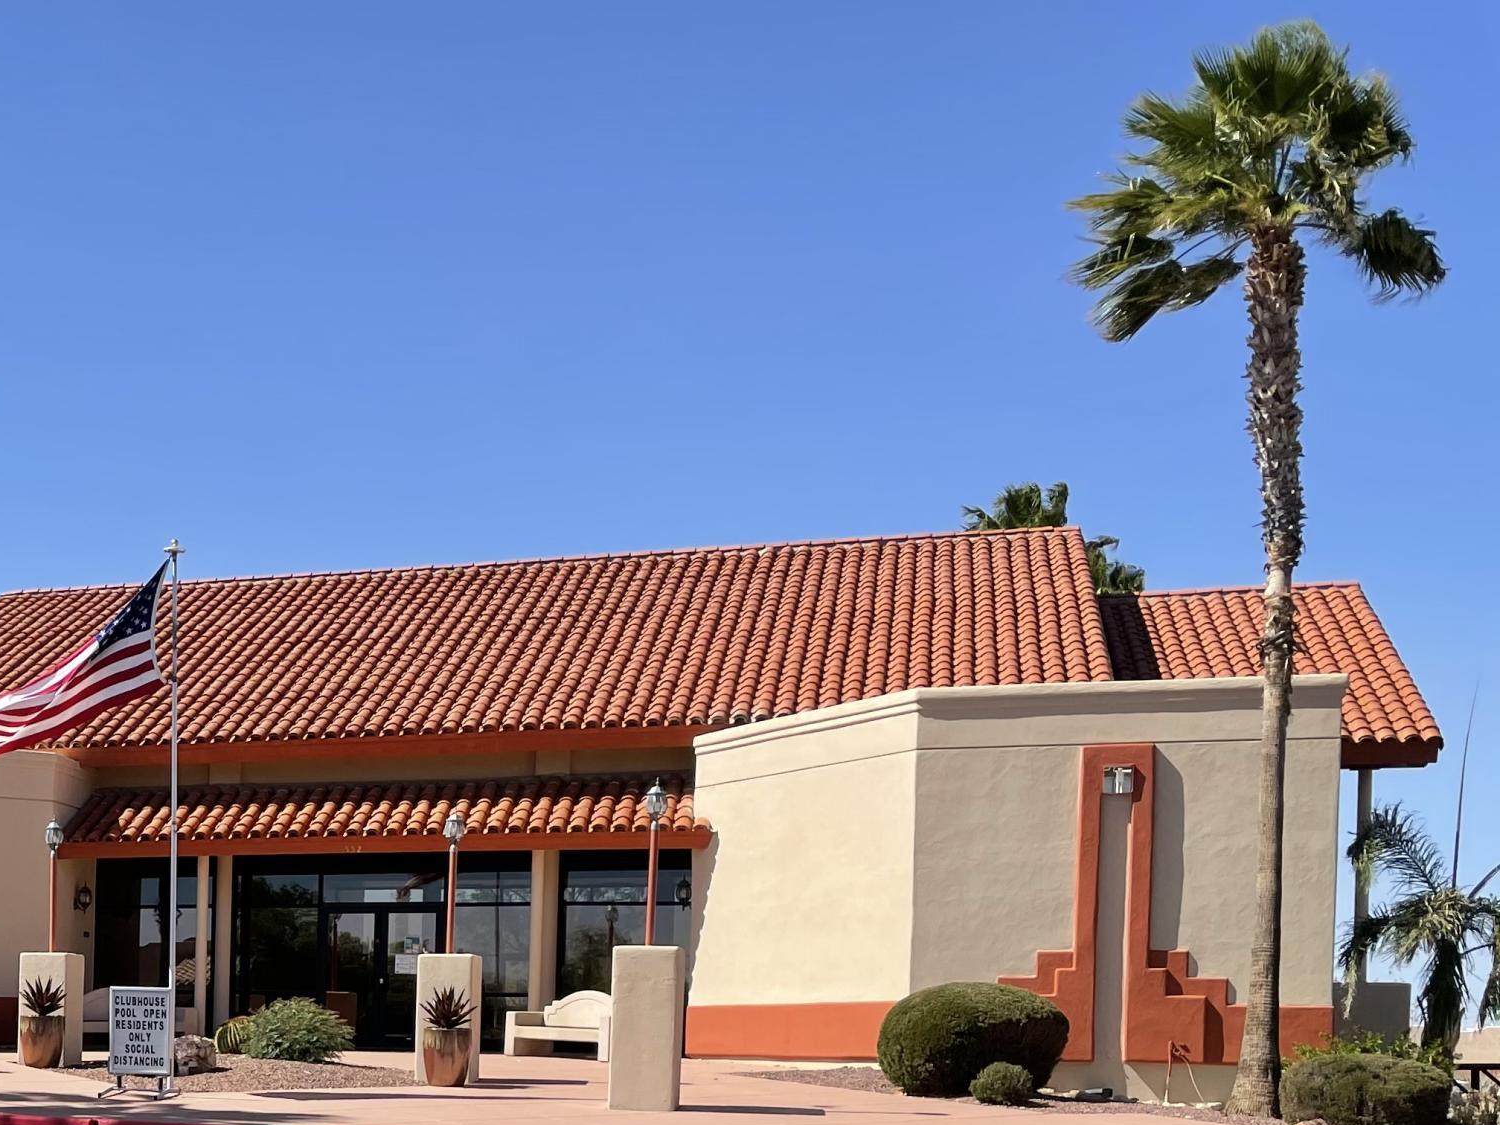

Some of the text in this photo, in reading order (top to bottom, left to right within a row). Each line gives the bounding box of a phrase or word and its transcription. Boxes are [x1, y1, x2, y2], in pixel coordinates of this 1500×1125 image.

[114, 996, 166, 1007] CLUBHOUSE
[114, 1008, 167, 1019] POOL OPEN
[115, 1020, 165, 1031] RESIDENTS
[128, 1032, 152, 1042] ONLY
[124, 1044, 156, 1054] SOCIAL
[113, 1056, 165, 1067] DISTANCING
